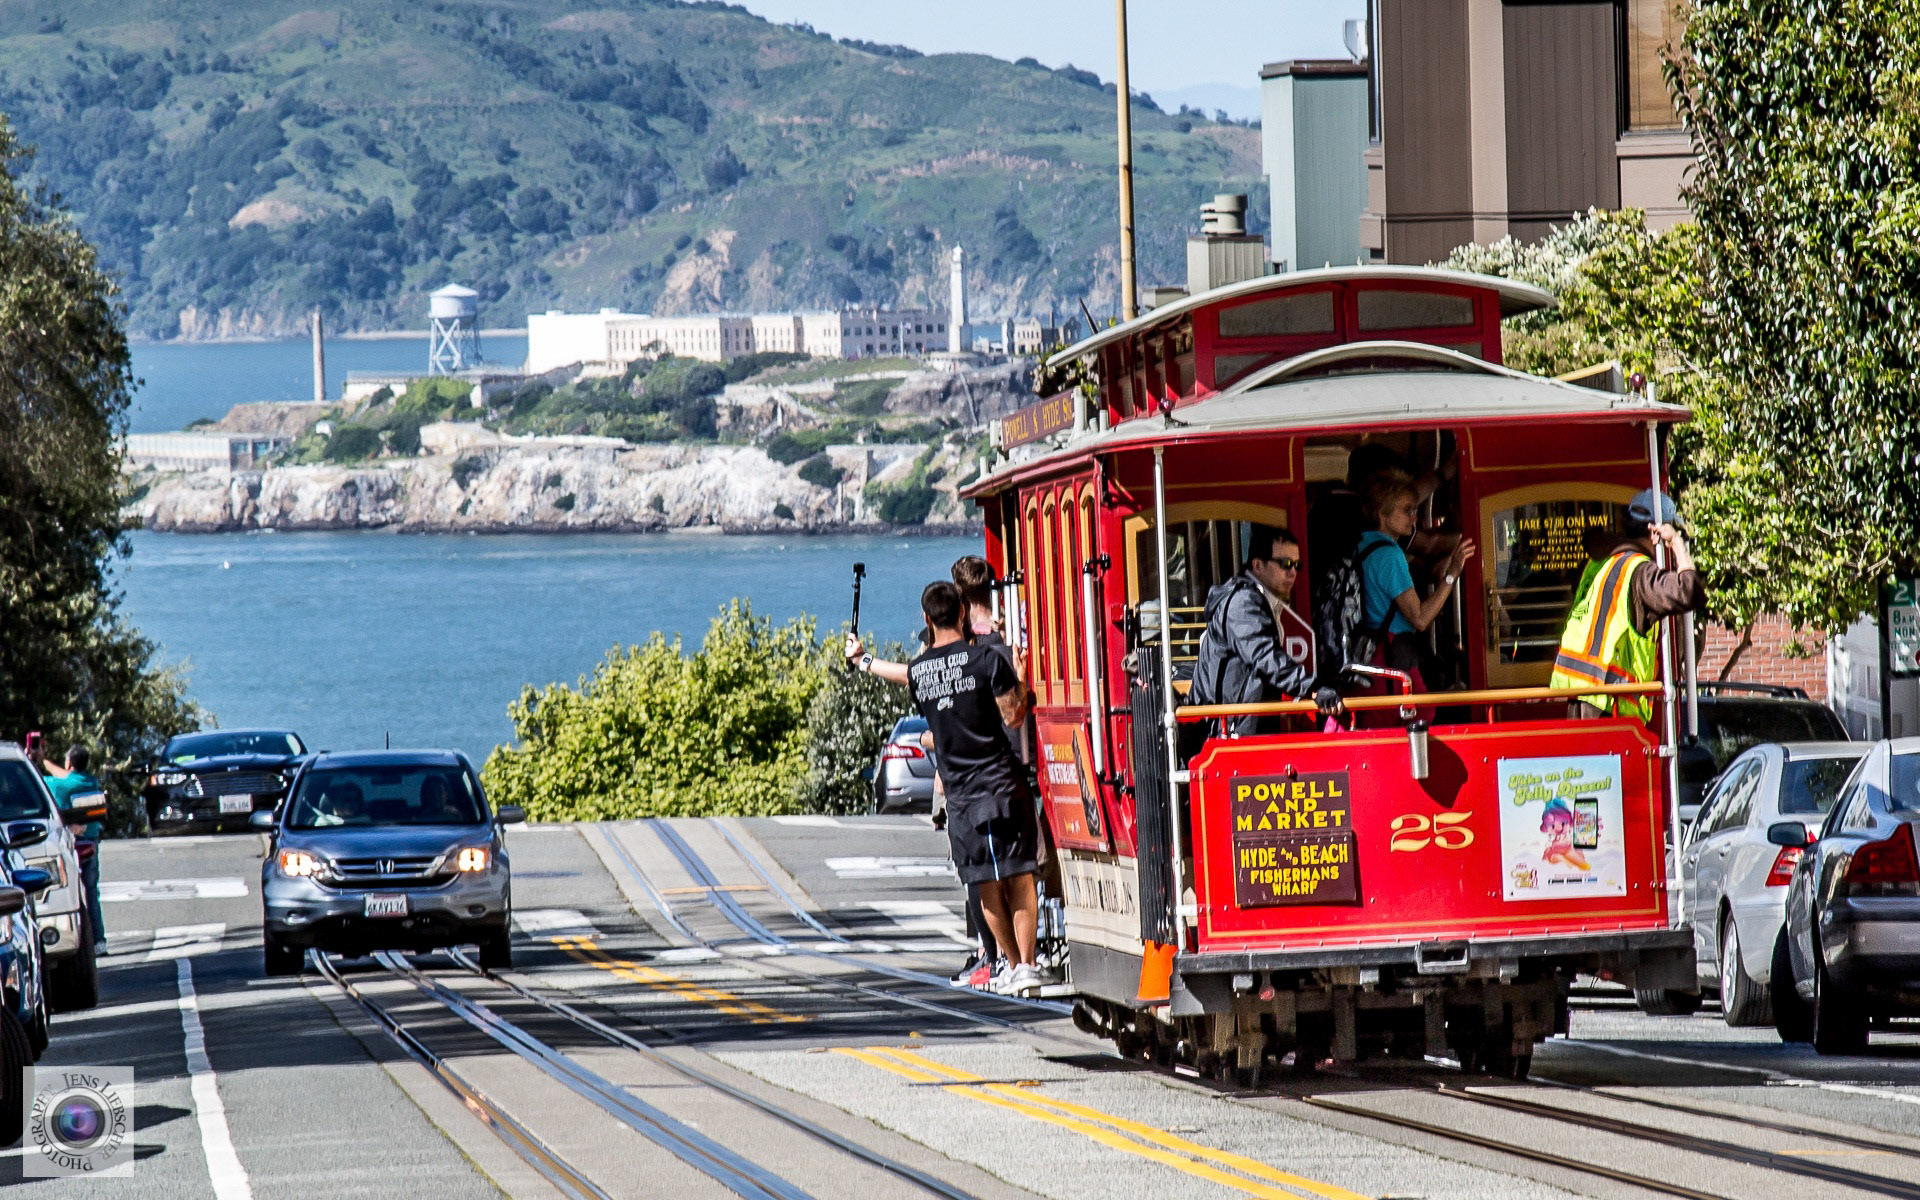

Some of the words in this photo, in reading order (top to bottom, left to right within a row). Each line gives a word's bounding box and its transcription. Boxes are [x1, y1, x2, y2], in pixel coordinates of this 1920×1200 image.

[1042, 399, 1061, 431] HYDE
[1519, 517, 1541, 531] FARE
[1566, 515, 1586, 529] ONE
[1588, 513, 1609, 528] WAY
[1894, 582, 1909, 602] 2
[1508, 774, 1543, 789] Take
[1544, 771, 1561, 782] on
[1562, 767, 1584, 780] the
[1237, 780, 1343, 802] POWELL
[1513, 785, 1553, 806] Jelly
[1556, 776, 1612, 800] Queen!
[1265, 797, 1318, 814] AND
[1236, 809, 1346, 832] MARKET
[1389, 809, 1475, 853] 25
[1240, 846, 1277, 869] HYDE
[1280, 847, 1299, 866] AND
[1300, 843, 1349, 866] BEACH
[1250, 865, 1340, 885] FISHERMANS
[1272, 880, 1319, 897] WHARF
